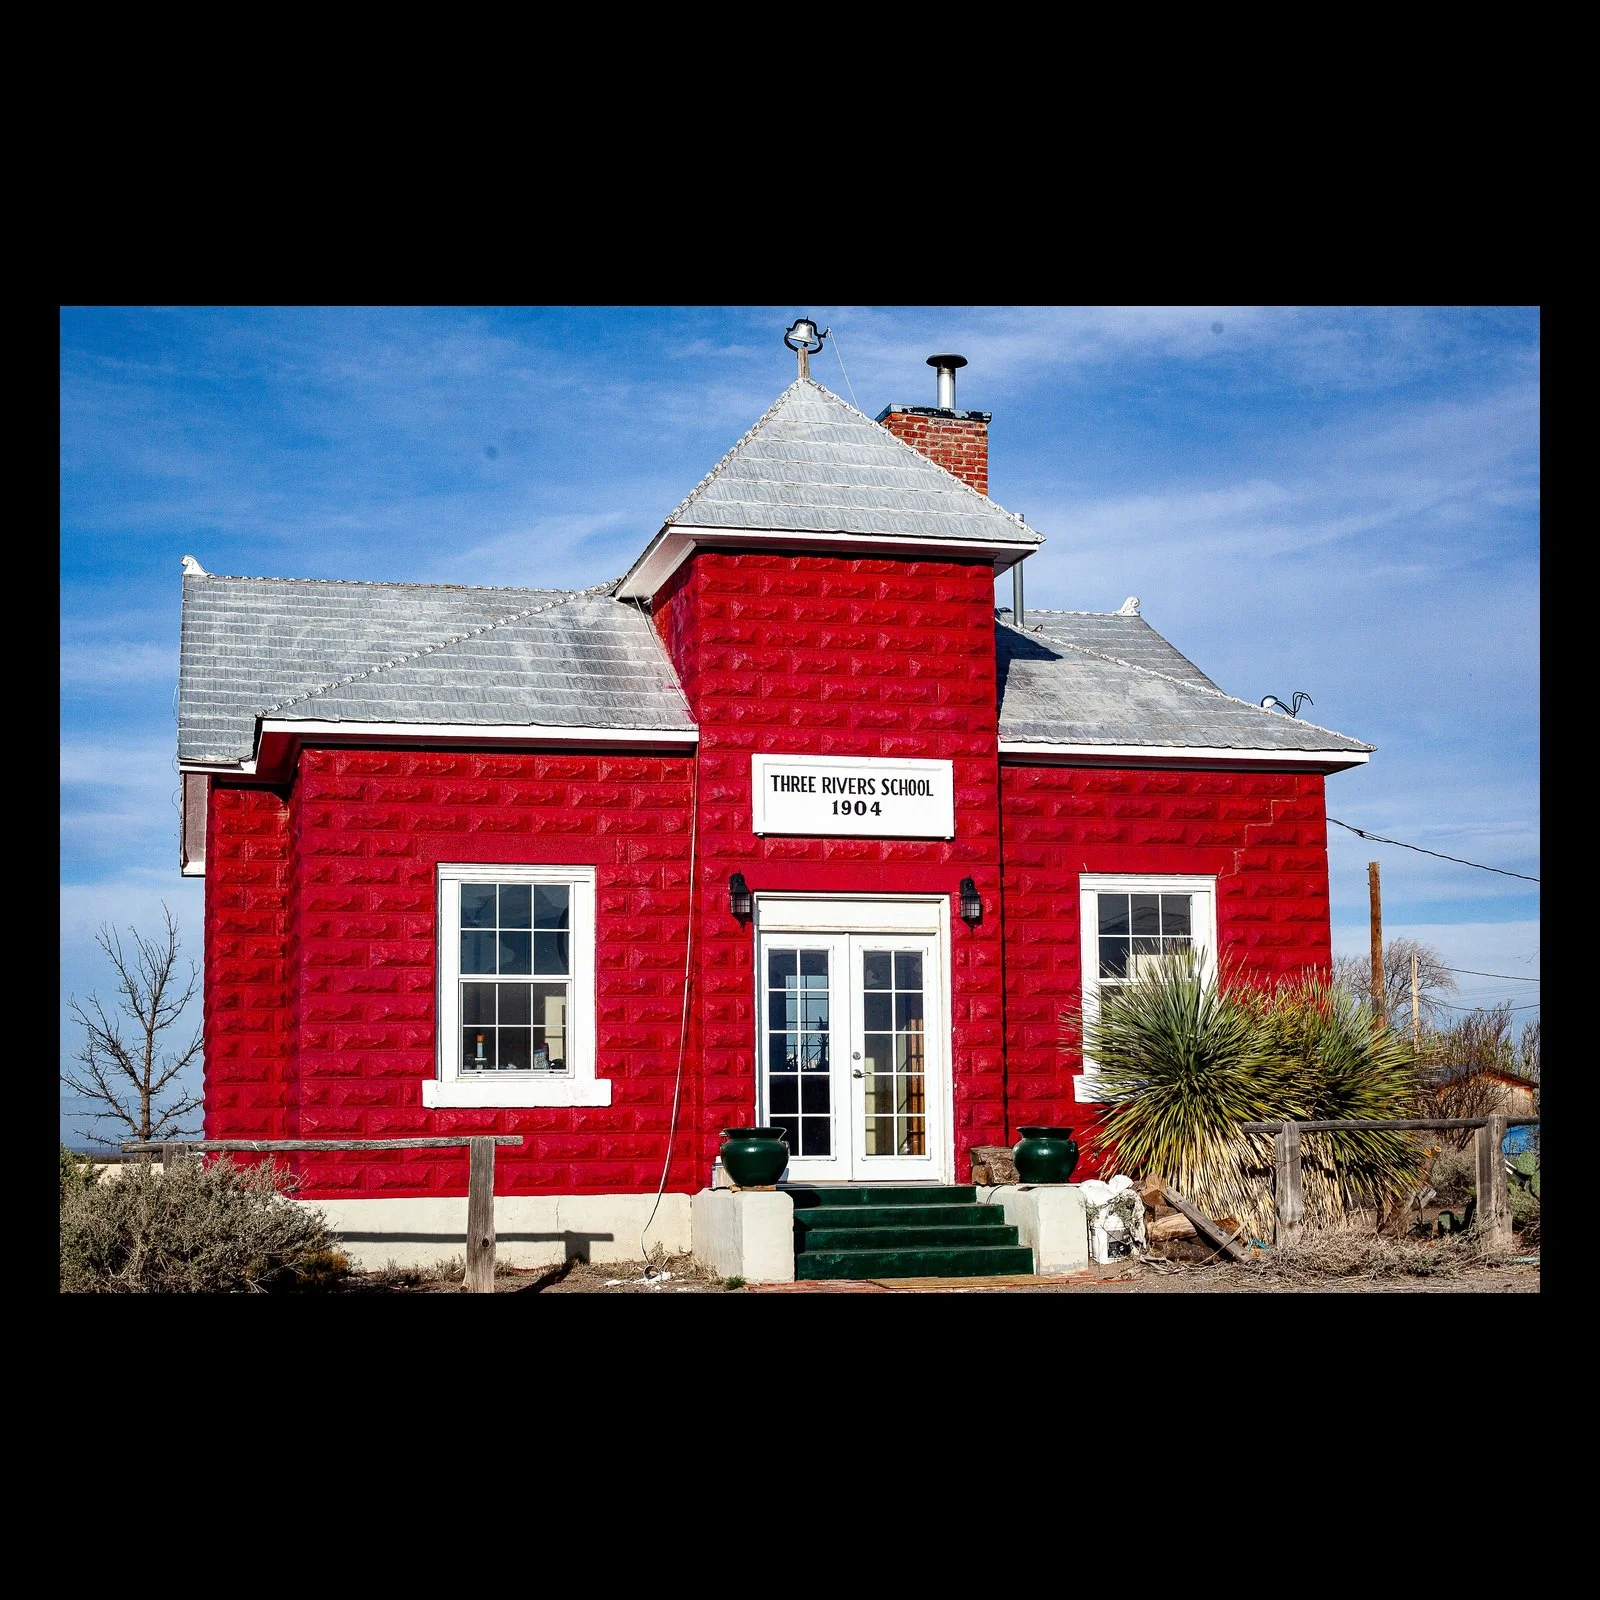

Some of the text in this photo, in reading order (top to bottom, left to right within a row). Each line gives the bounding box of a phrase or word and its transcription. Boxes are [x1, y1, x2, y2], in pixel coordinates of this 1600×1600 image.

[770, 774, 934, 797] THREE RIVERS SCHOOL
[832, 799, 882, 817] 1904
